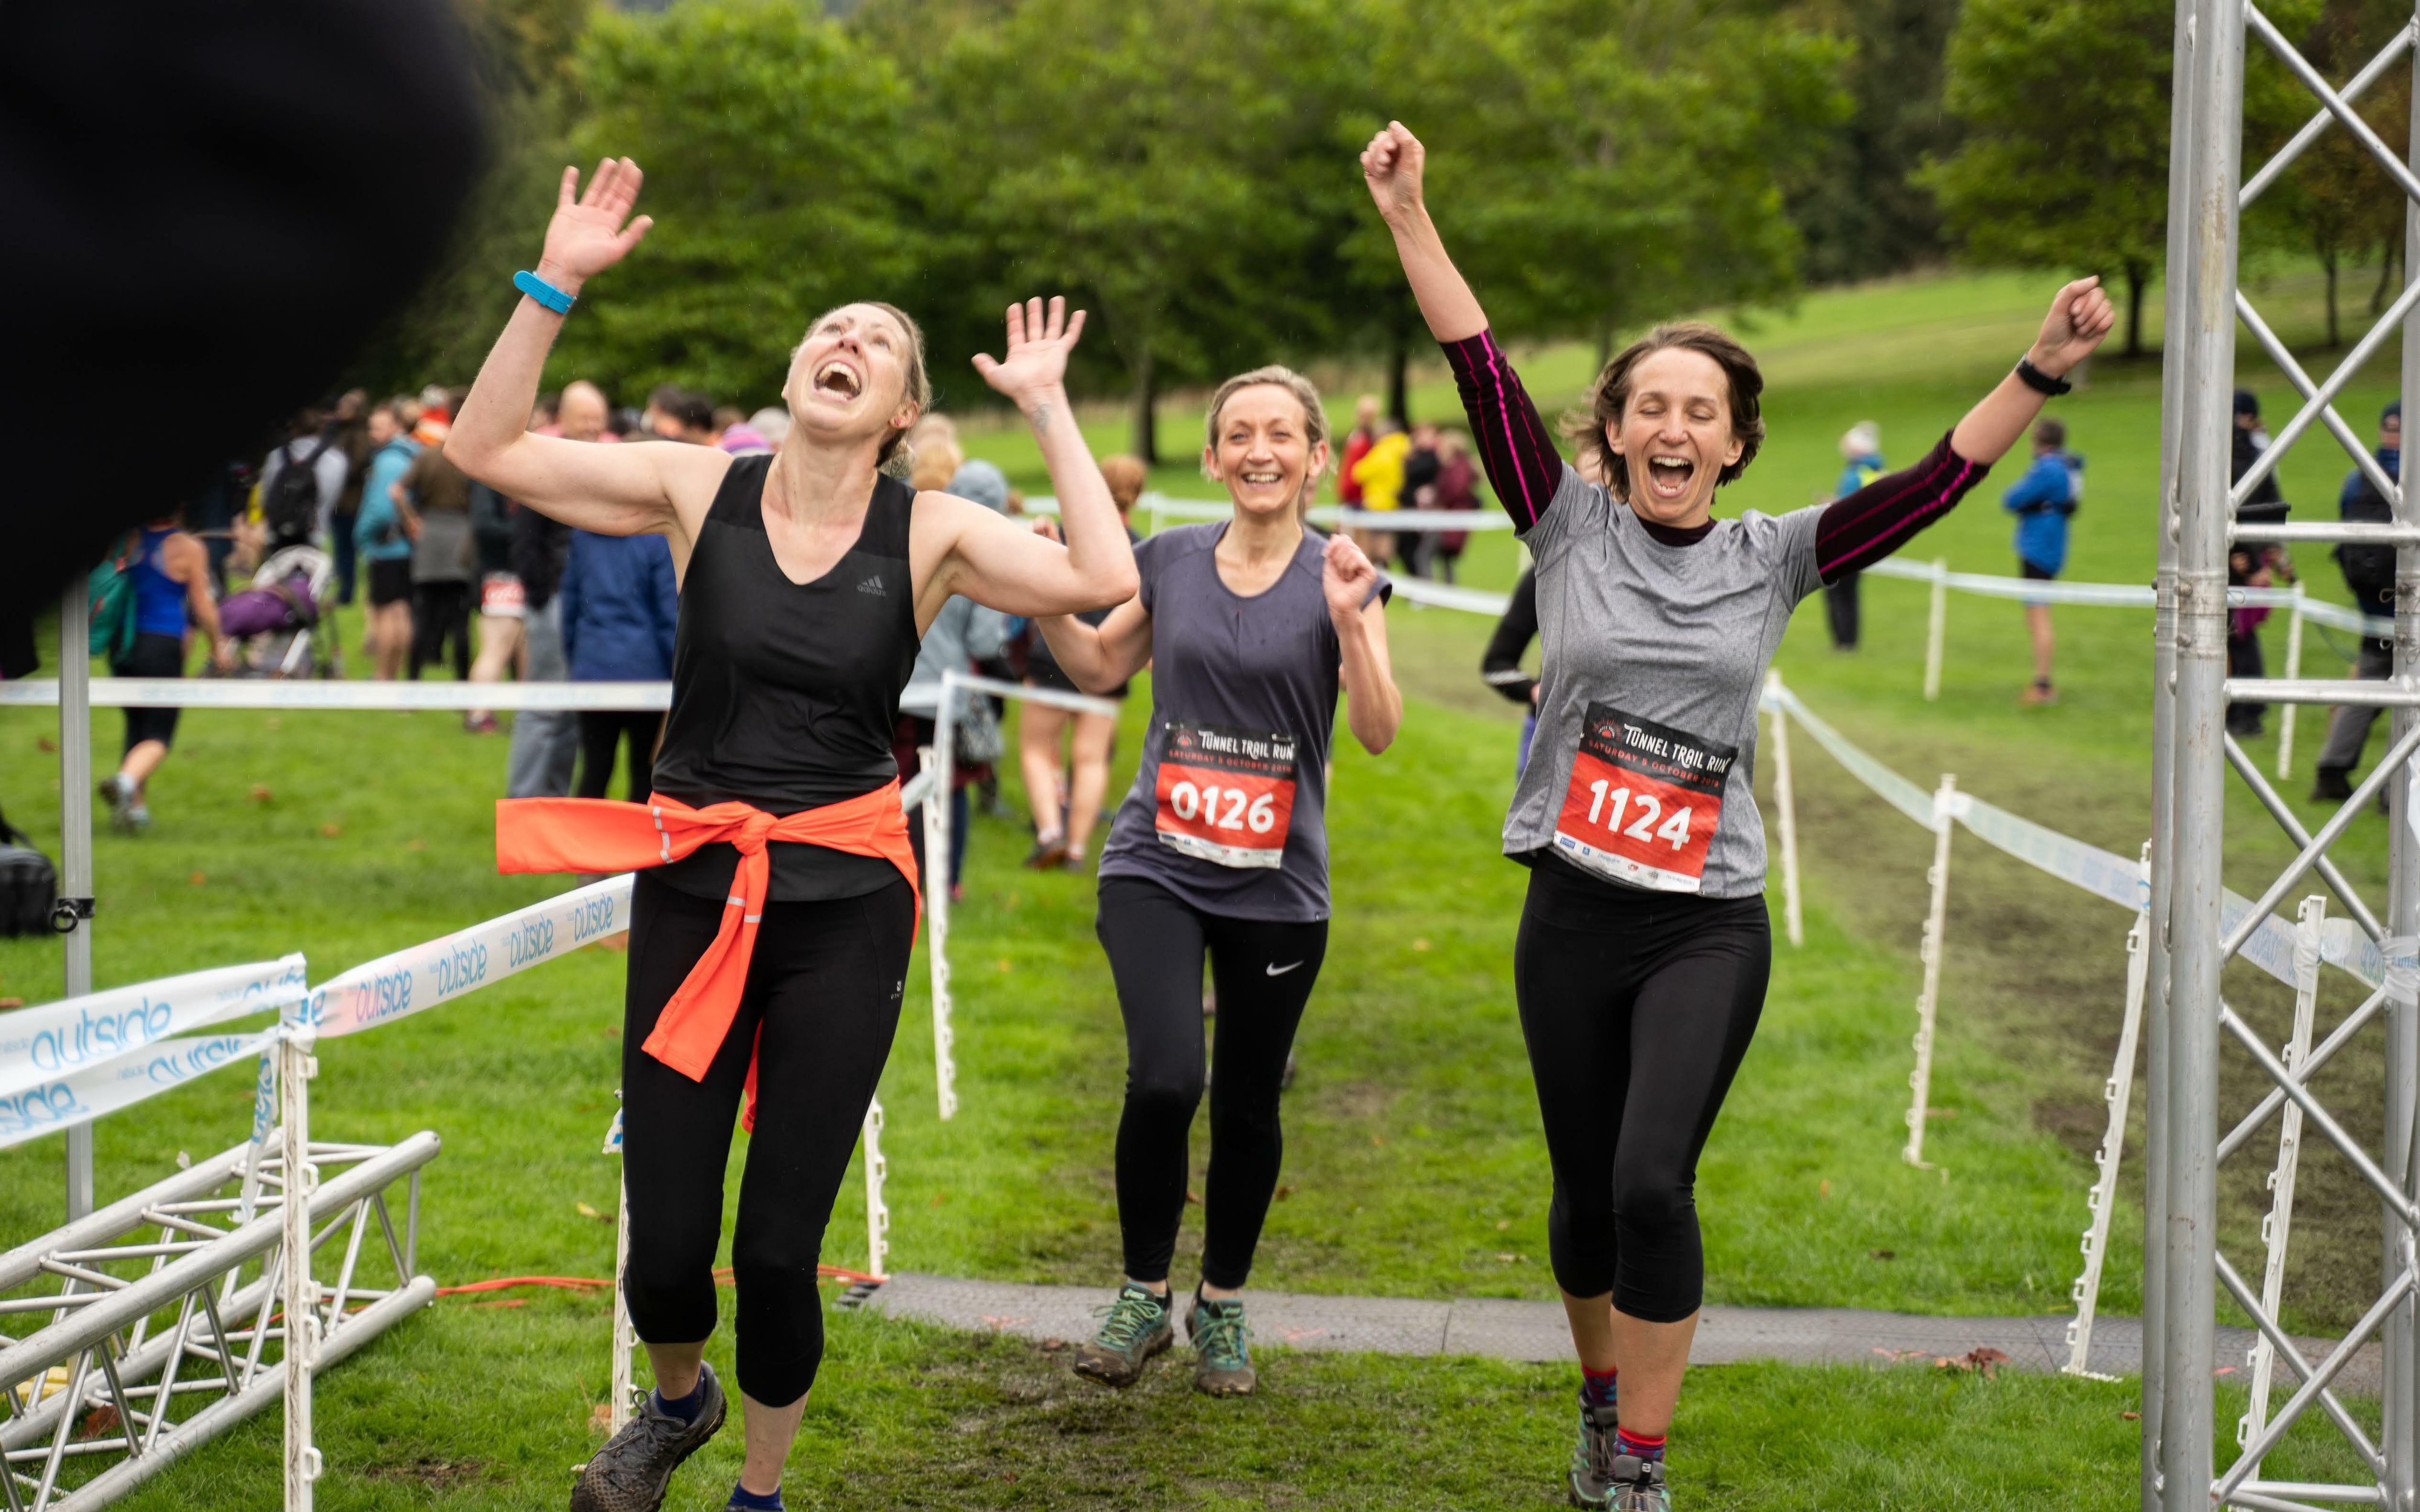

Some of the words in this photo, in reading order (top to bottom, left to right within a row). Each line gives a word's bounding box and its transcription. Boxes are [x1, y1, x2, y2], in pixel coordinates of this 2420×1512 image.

[1168, 749, 1214, 763] SATURDAY
[1226, 758, 1268, 771] OCTOBER
[1197, 729, 1238, 754] TUNNEL
[1241, 739, 1269, 760] TRAIL
[1272, 743, 1295, 761] RUN
[1589, 739, 1638, 763] SATURDAY
[1652, 760, 1699, 783] OCTOBER
[1624, 723, 1667, 757] TUNNEL
[1672, 743, 1703, 769] TRAIL
[1707, 755, 1732, 774] RUN
[1170, 781, 1275, 833] 0126
[1588, 779, 1692, 851] 1124
[510, 914, 553, 968] outside
[575, 893, 613, 942] outside
[356, 964, 412, 1023] outside
[439, 938, 487, 997] outside
[30, 997, 172, 1070] outside
